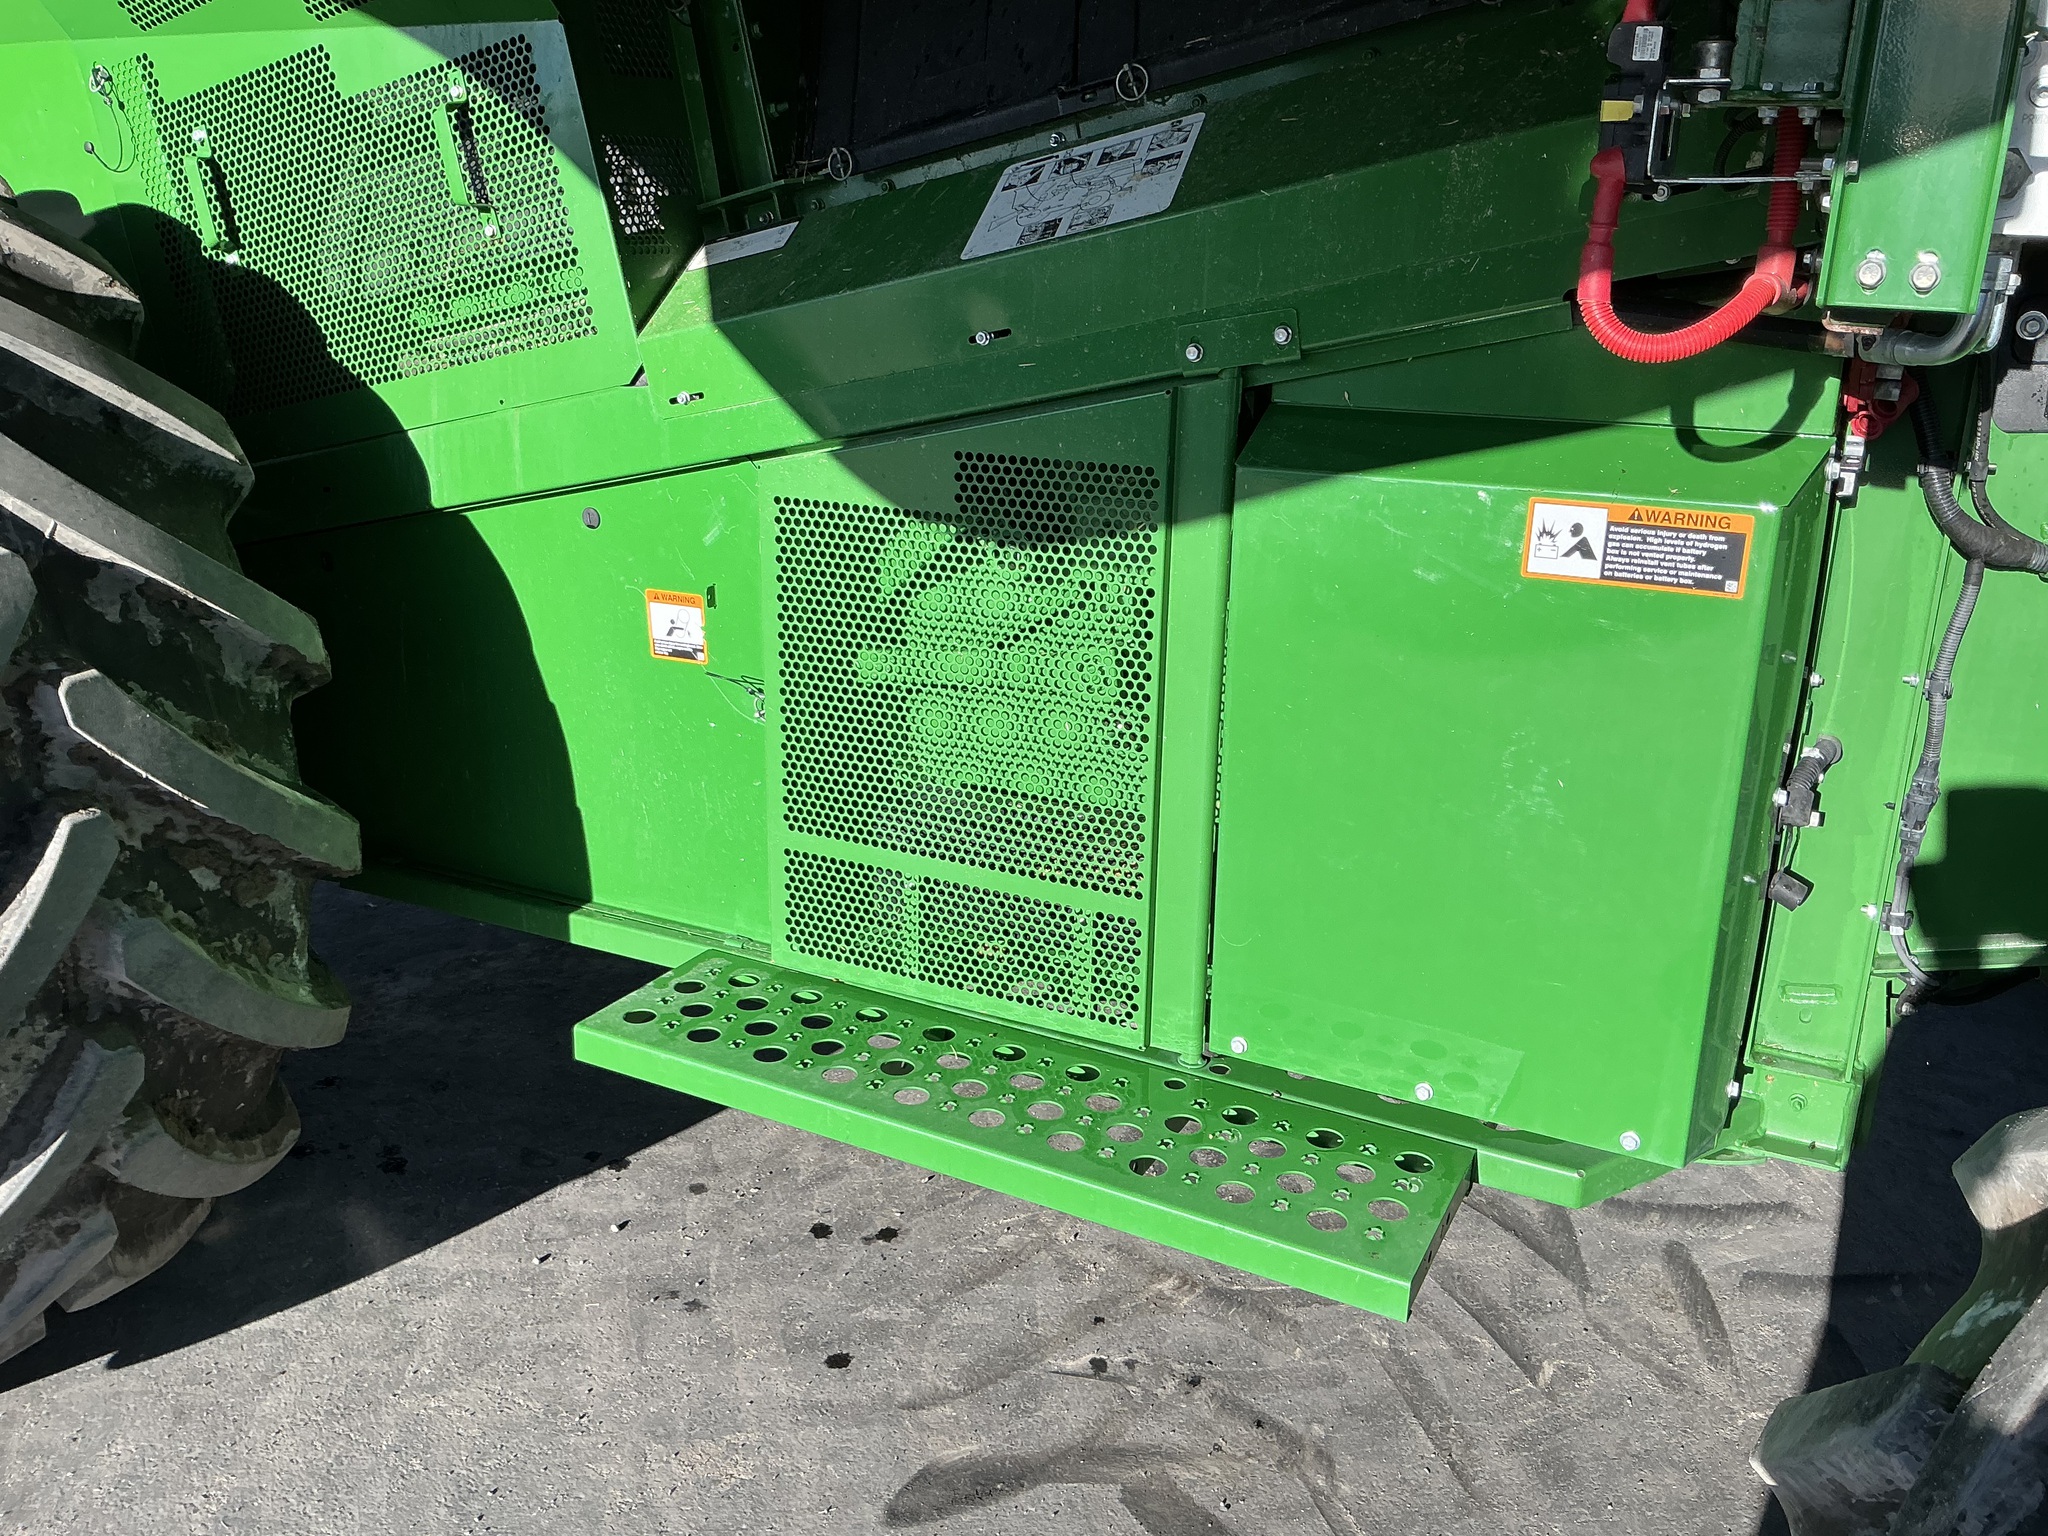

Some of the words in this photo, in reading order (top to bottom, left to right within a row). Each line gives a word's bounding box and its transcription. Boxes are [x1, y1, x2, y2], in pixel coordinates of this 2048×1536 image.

[1645, 509, 1732, 529] WARNING
[1657, 530, 1678, 538] injury
[1608, 534, 1643, 542] explosion.
[1664, 538, 1684, 546] levels
[1694, 541, 1728, 550] hydrogen
[1635, 544, 1674, 552] accumulate
[1682, 548, 1707, 557] battery
[1605, 556, 1630, 564] Always
[1631, 558, 1659, 566] reinstall
[1676, 562, 1696, 570] tubes
[1665, 554, 1696, 563] properly.
[1604, 563, 1641, 573] performing
[1678, 570, 1723, 580] maintenance
[1614, 571, 1644, 580] batteries
[1653, 575, 1679, 584] battery
[1679, 577, 1695, 585] box.
[661, 593, 695, 604] WARNING
